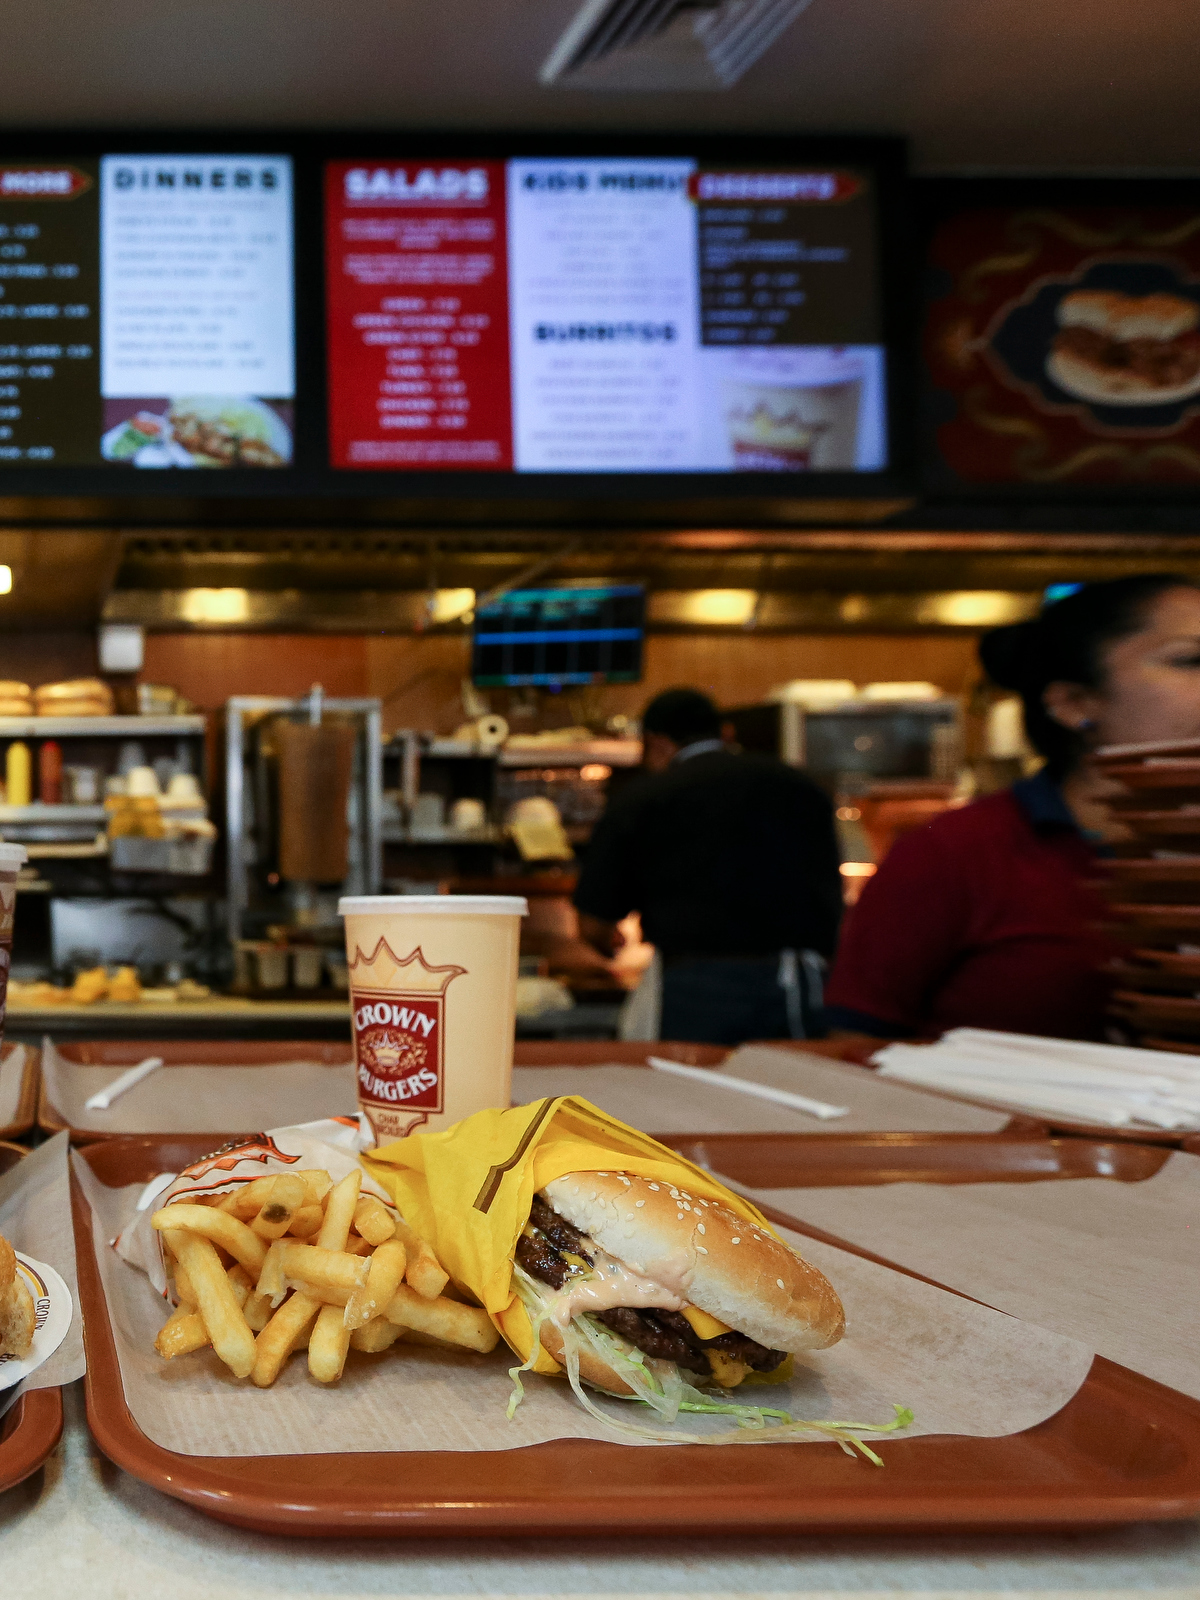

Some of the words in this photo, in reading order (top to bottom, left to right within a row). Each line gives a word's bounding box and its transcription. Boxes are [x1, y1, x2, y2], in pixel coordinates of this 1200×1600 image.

[112, 168, 278, 190] DINNERS
[344, 167, 489, 200] SALADS
[355, 1002, 437, 1038] CROWN
[359, 1063, 438, 1101] BURGERS
[35, 1298, 51, 1330] CROWN
